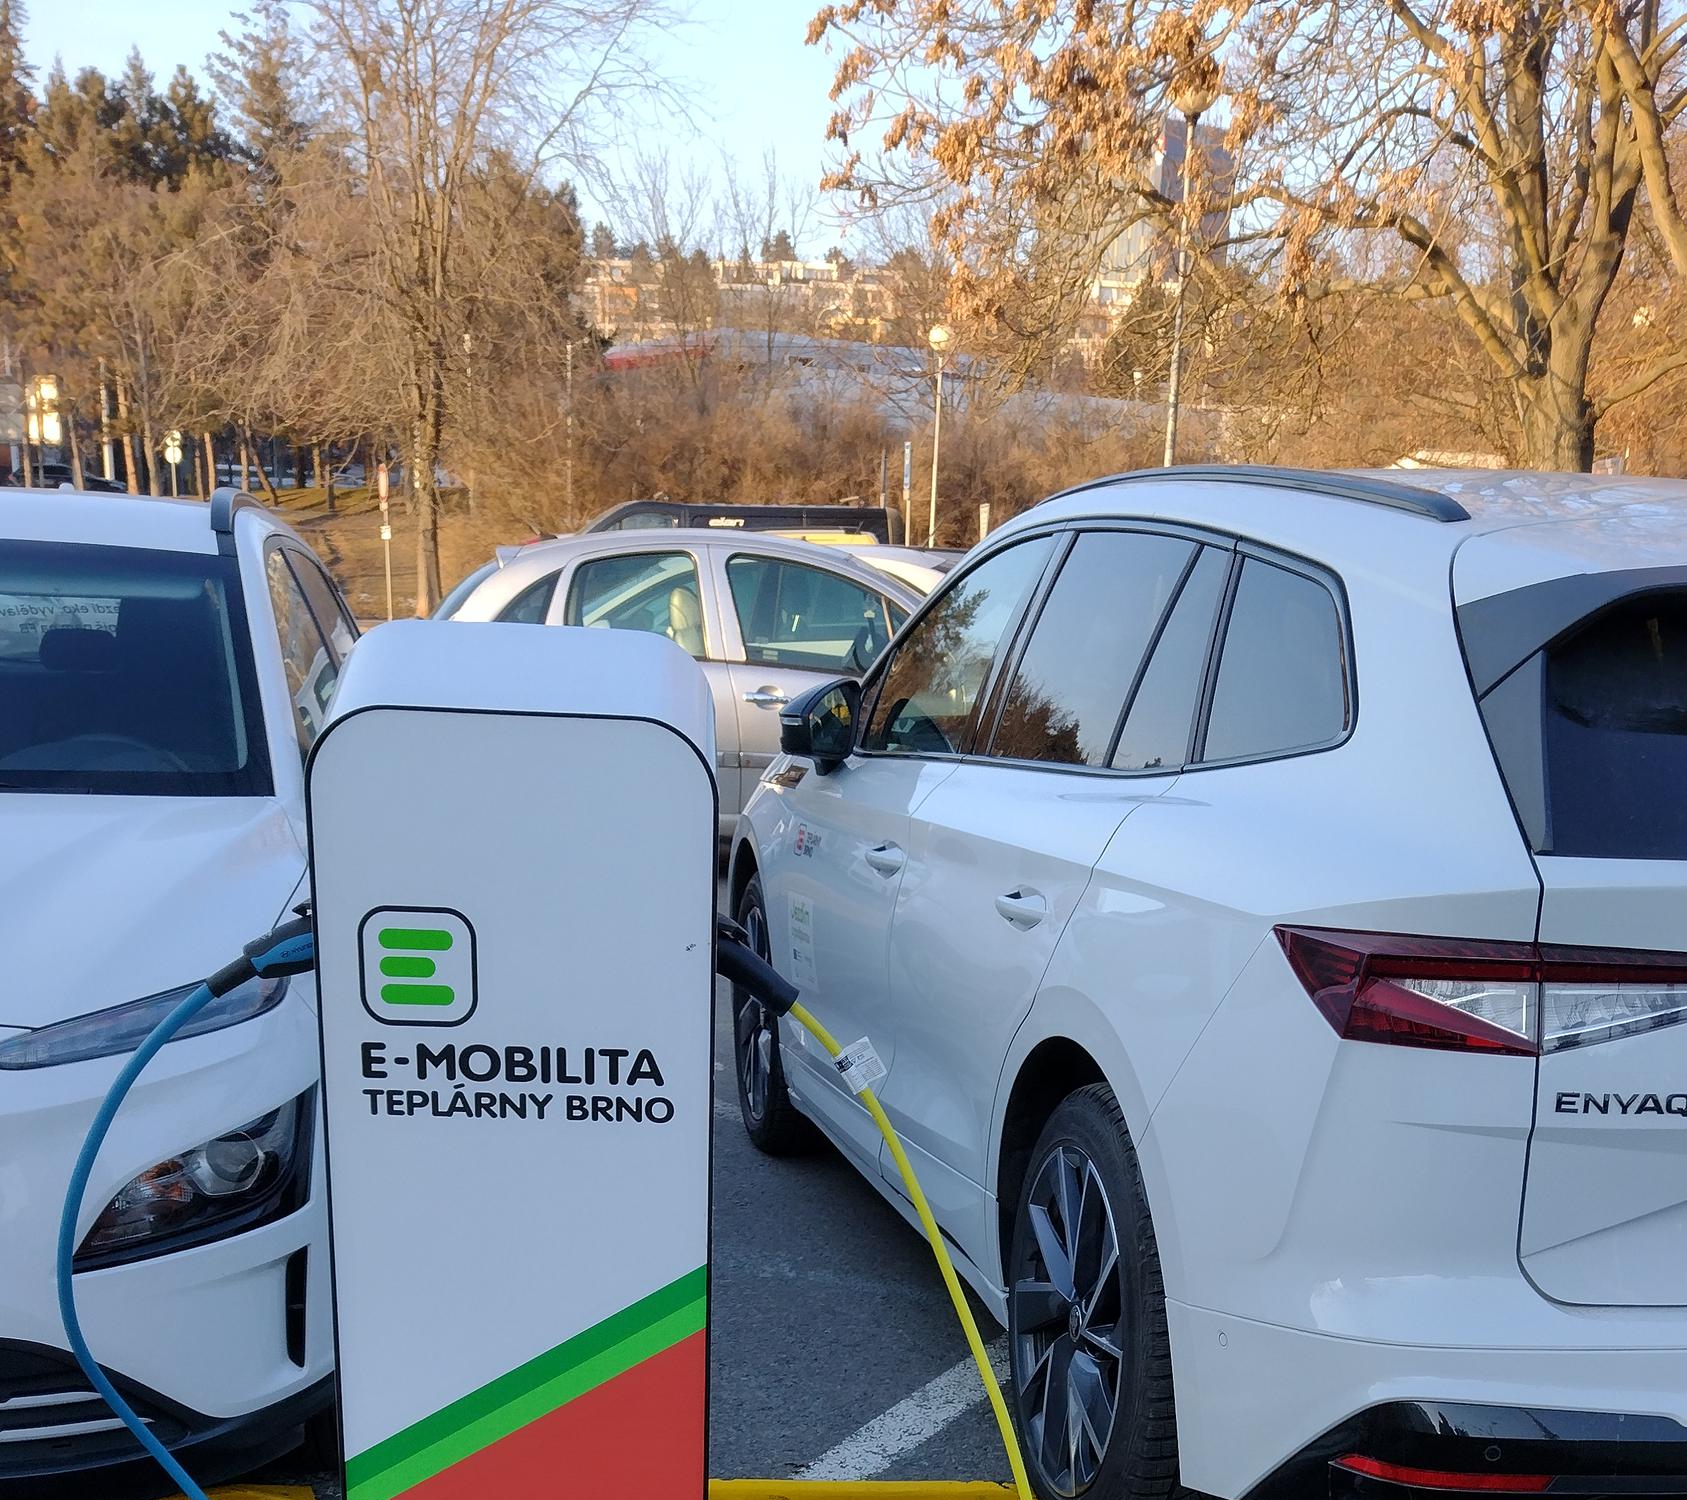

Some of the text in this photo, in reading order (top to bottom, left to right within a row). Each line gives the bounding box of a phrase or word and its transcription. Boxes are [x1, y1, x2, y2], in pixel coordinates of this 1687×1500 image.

[361, 1042, 665, 1086] E-MOBILITA
[362, 1083, 675, 1124] TEPLÁRNY BRNO
[1555, 1091, 1687, 1117] ENYAQ
